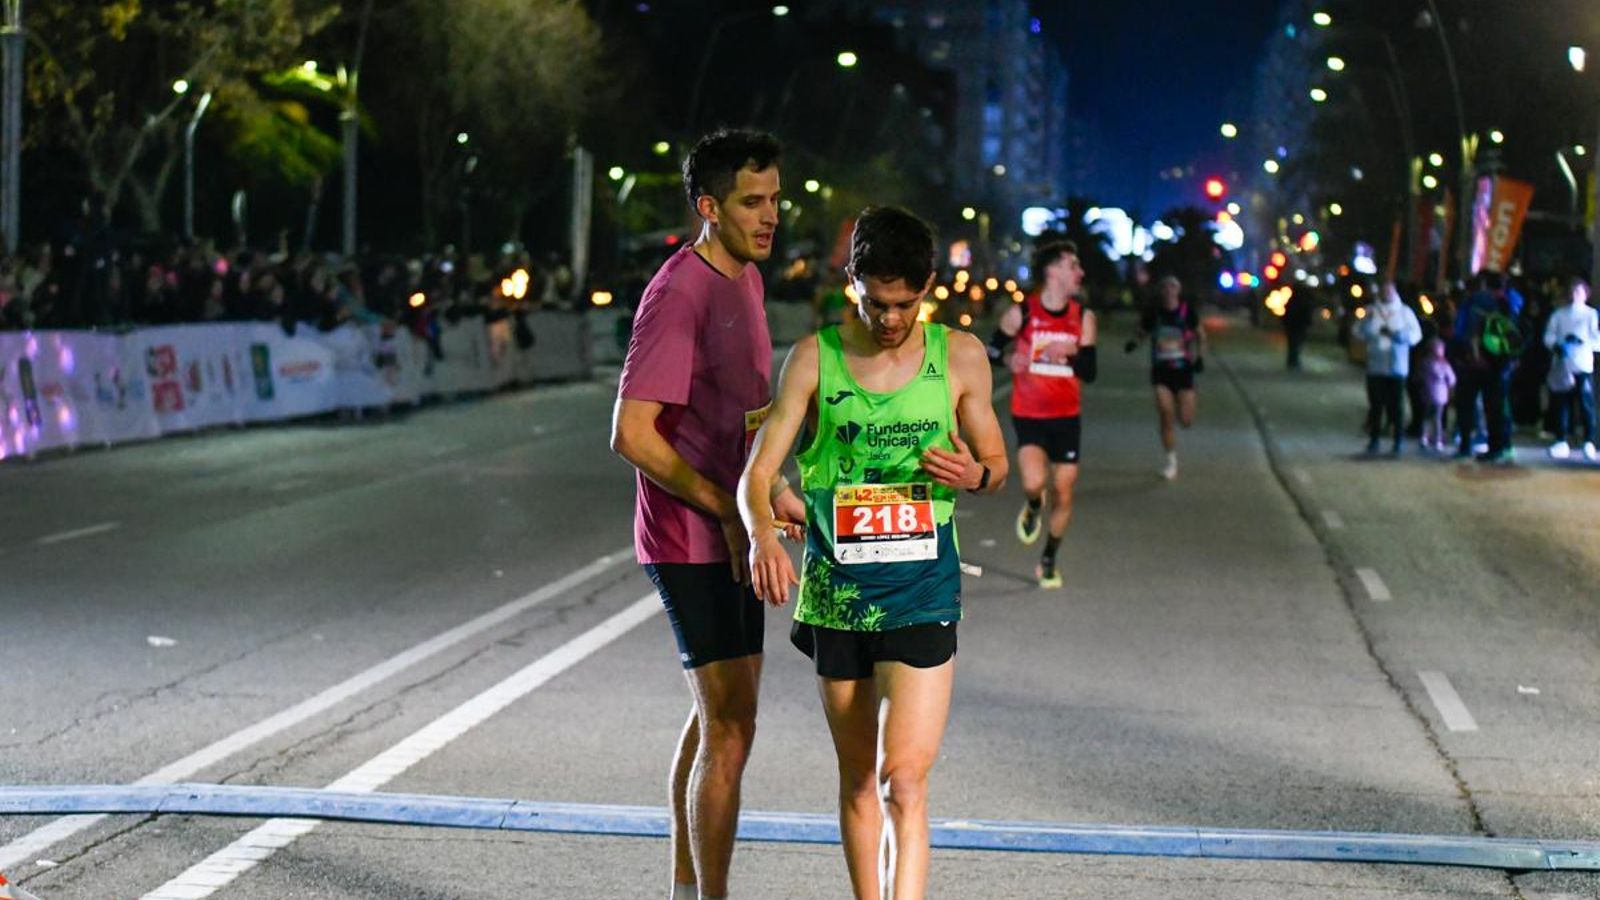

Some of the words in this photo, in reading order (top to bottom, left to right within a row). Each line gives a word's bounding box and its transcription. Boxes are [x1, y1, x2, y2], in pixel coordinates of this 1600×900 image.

[867, 419, 939, 436] Fundación
[867, 434, 920, 449] Unicaja
[854, 488, 873, 502] 42
[853, 505, 917, 534] 218
